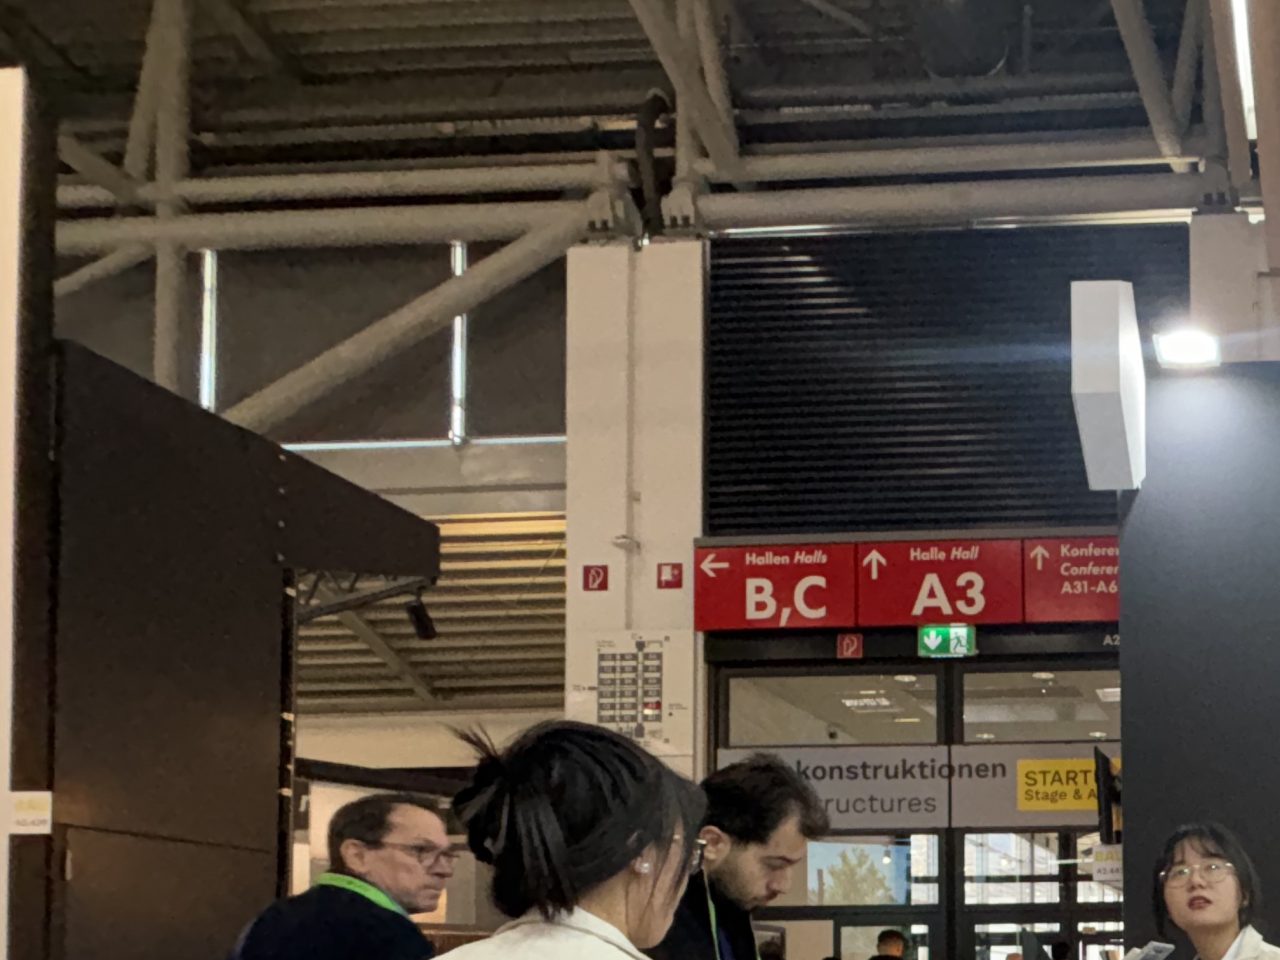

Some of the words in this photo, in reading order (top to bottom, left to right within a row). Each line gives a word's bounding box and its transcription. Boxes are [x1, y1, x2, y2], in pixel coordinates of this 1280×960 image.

[745, 552, 790, 565] Hallen
[794, 550, 828, 564] Halls
[910, 547, 946, 561] Halle
[951, 546, 980, 560] Hall
[745, 575, 827, 627] B,C
[911, 571, 986, 616] A3
[1024, 788, 1067, 804] Stage
[1072, 788, 1082, 800] &
